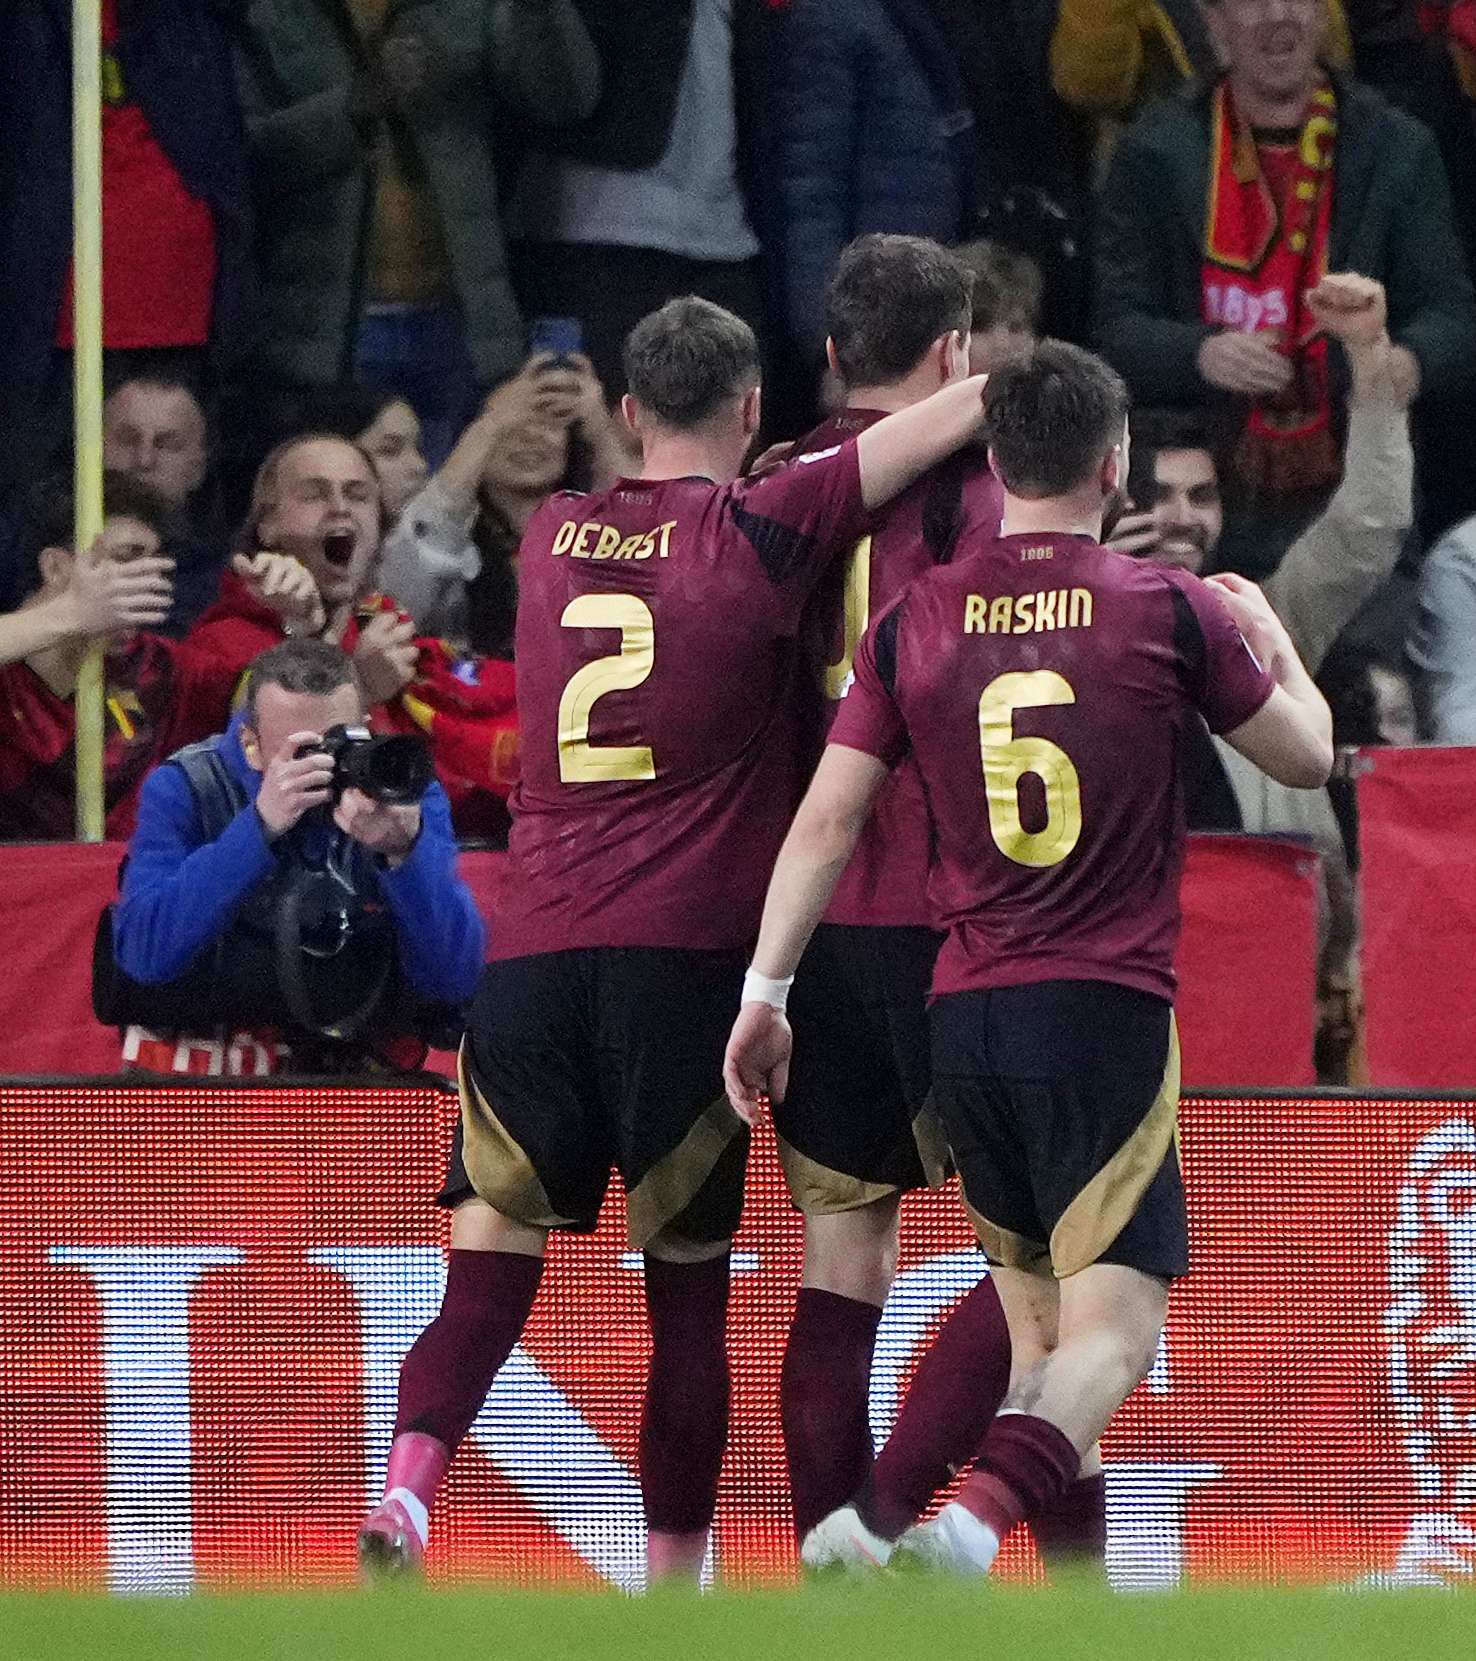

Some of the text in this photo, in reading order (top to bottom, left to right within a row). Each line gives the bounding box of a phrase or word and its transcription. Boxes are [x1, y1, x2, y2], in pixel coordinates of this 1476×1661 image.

[551, 520, 678, 560] DEBAST
[963, 588, 1093, 634] RASKIN
[557, 593, 656, 784] 2
[978, 669, 1082, 868] 6
